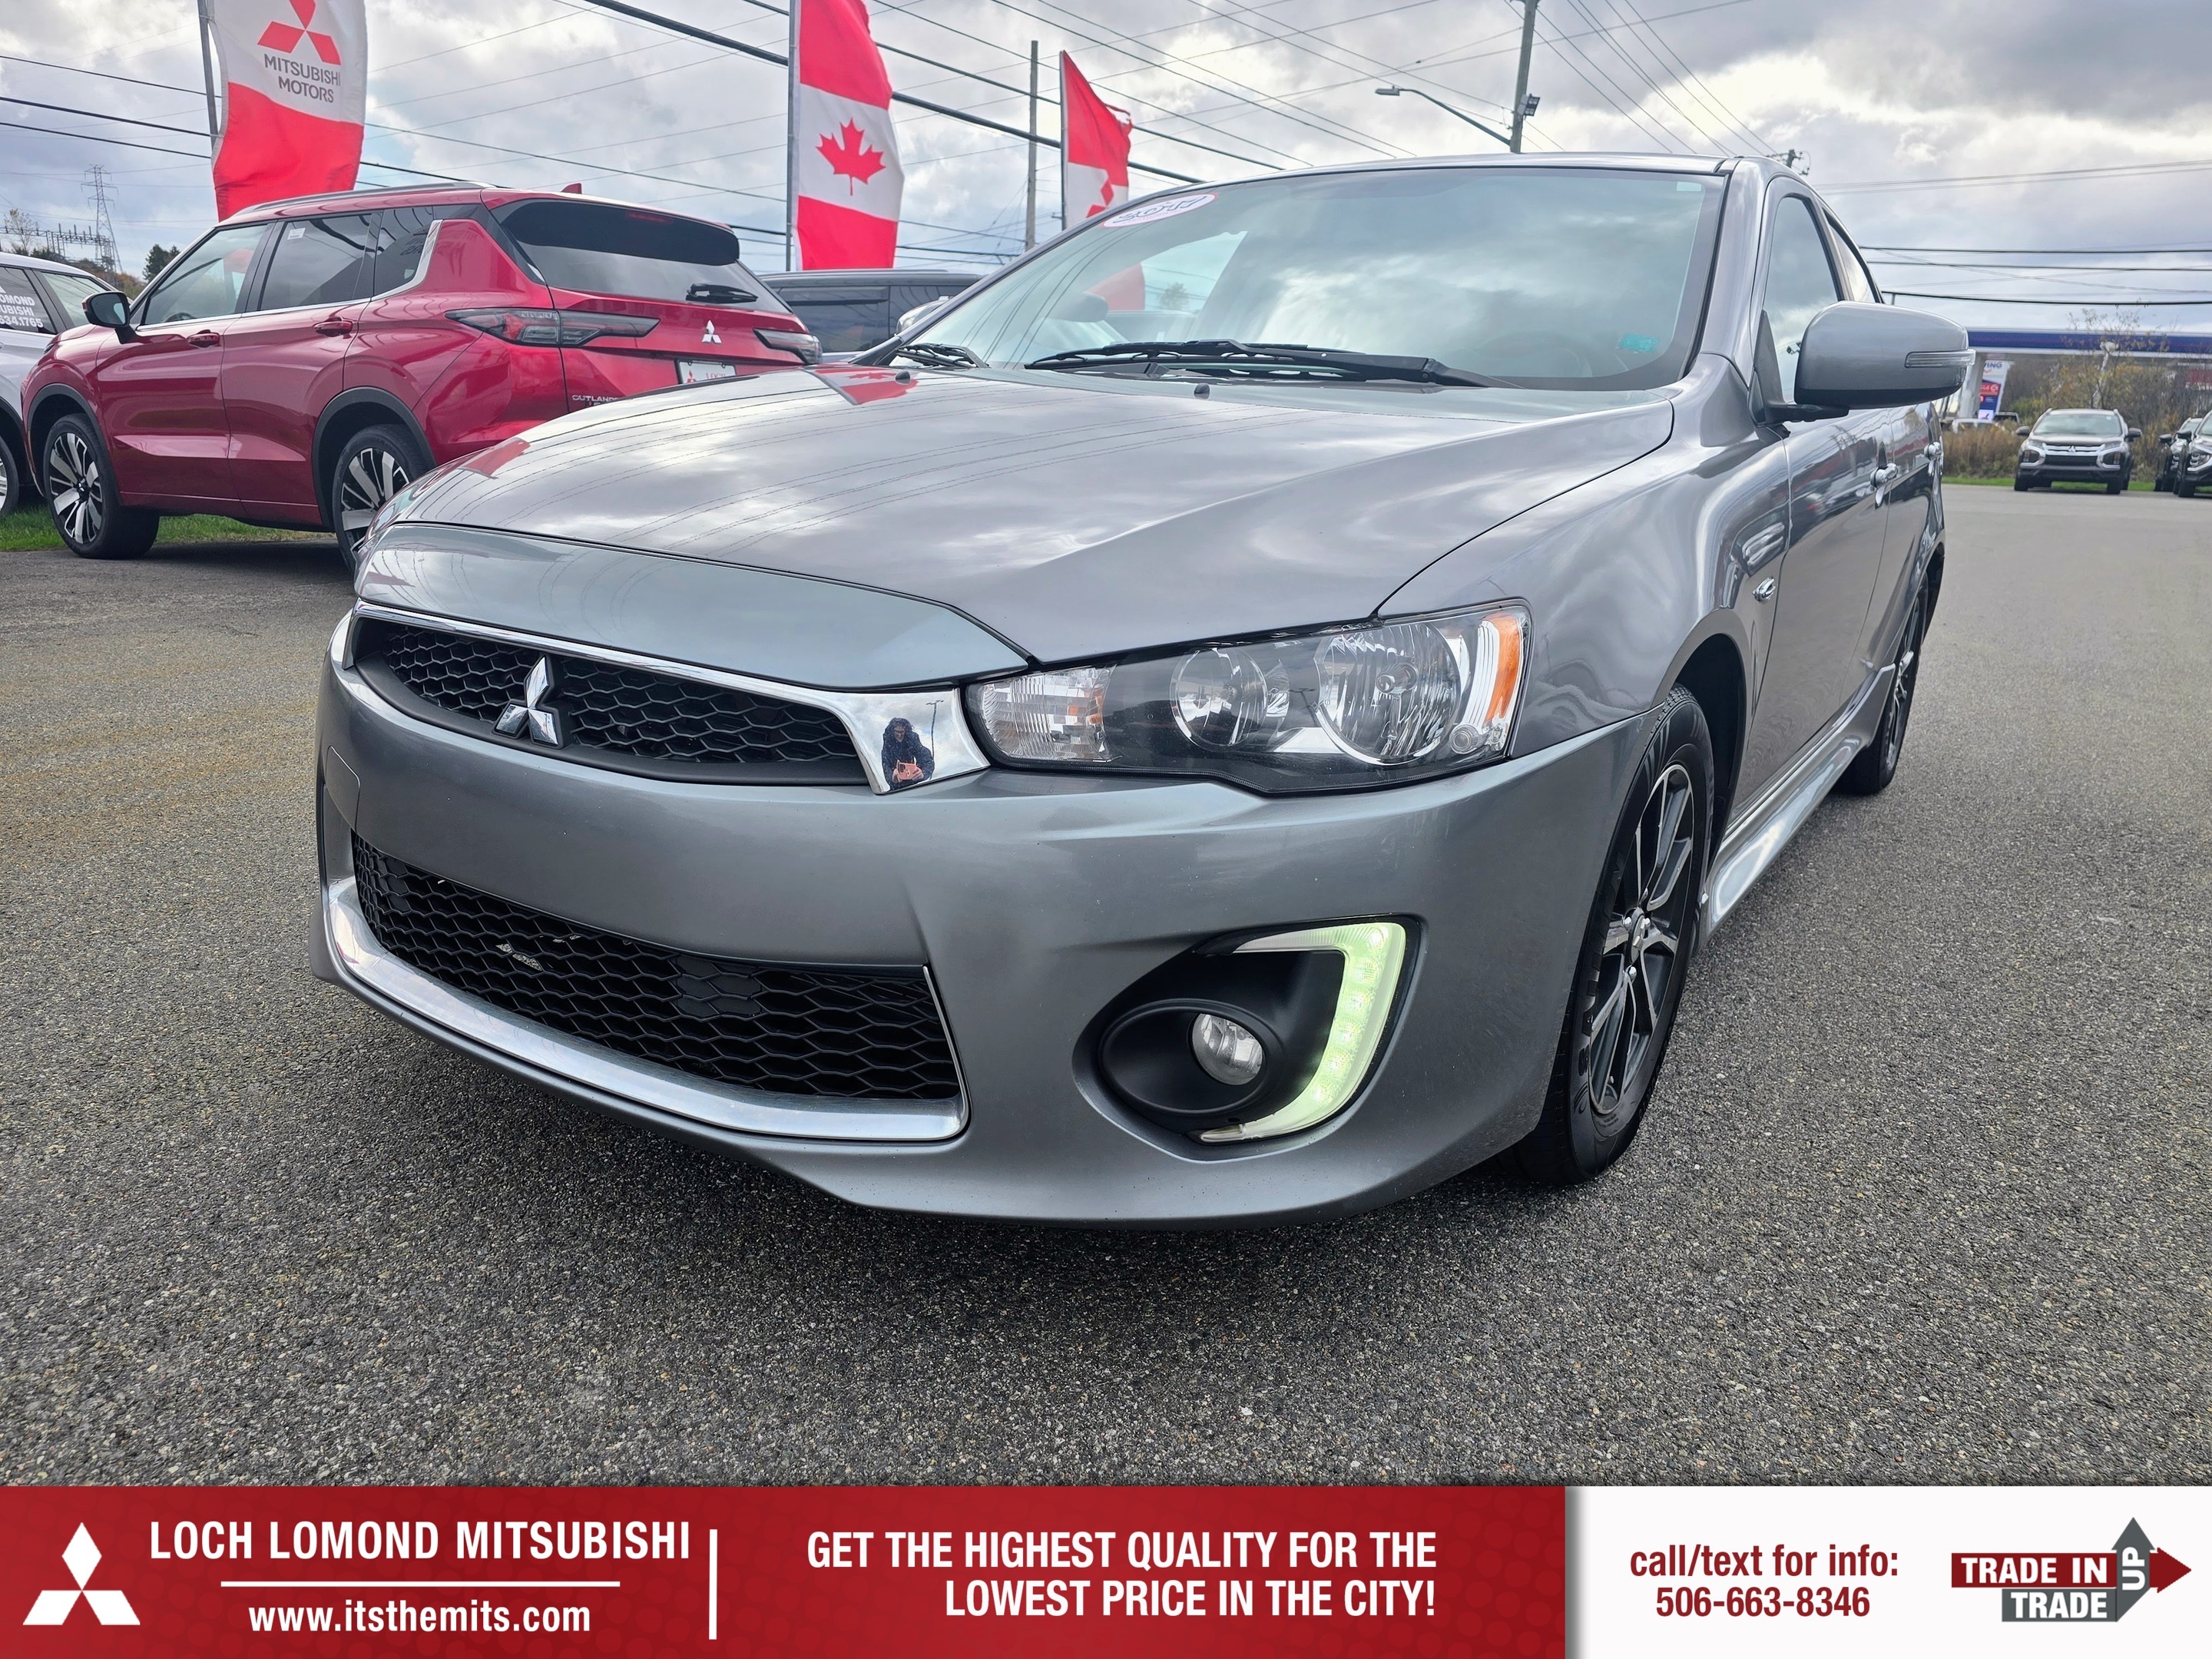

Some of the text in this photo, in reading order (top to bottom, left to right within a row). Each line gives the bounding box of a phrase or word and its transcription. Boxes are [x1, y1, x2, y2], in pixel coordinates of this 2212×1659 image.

[264, 54, 341, 86] MITSUBISHI
[278, 76, 334, 103] MOTORS
[0, 304, 35, 316] UBISHI
